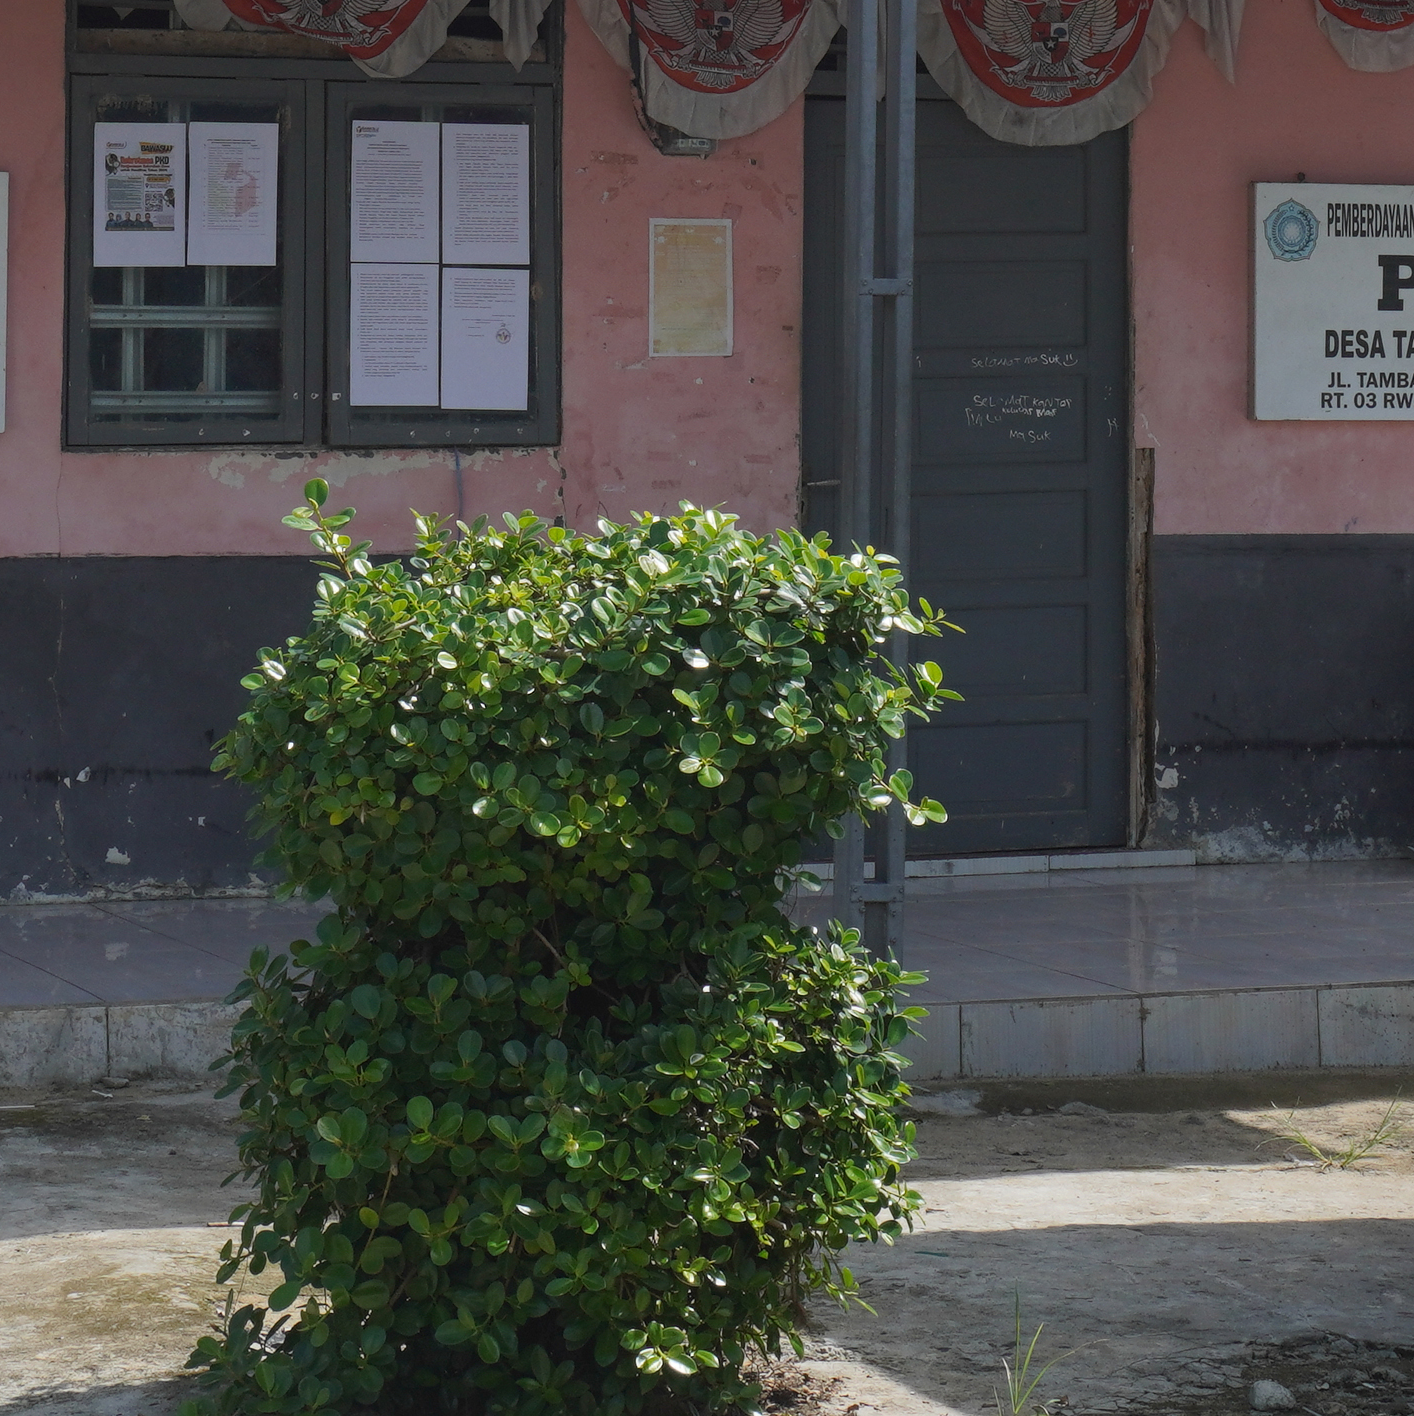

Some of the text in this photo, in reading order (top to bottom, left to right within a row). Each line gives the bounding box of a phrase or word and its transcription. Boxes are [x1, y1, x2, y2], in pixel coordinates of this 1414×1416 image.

[1325, 330, 1385, 358] DESA
[1328, 372, 1351, 388] JL.
[1321, 393, 1348, 409] RT.
[1354, 393, 1377, 409] 03
